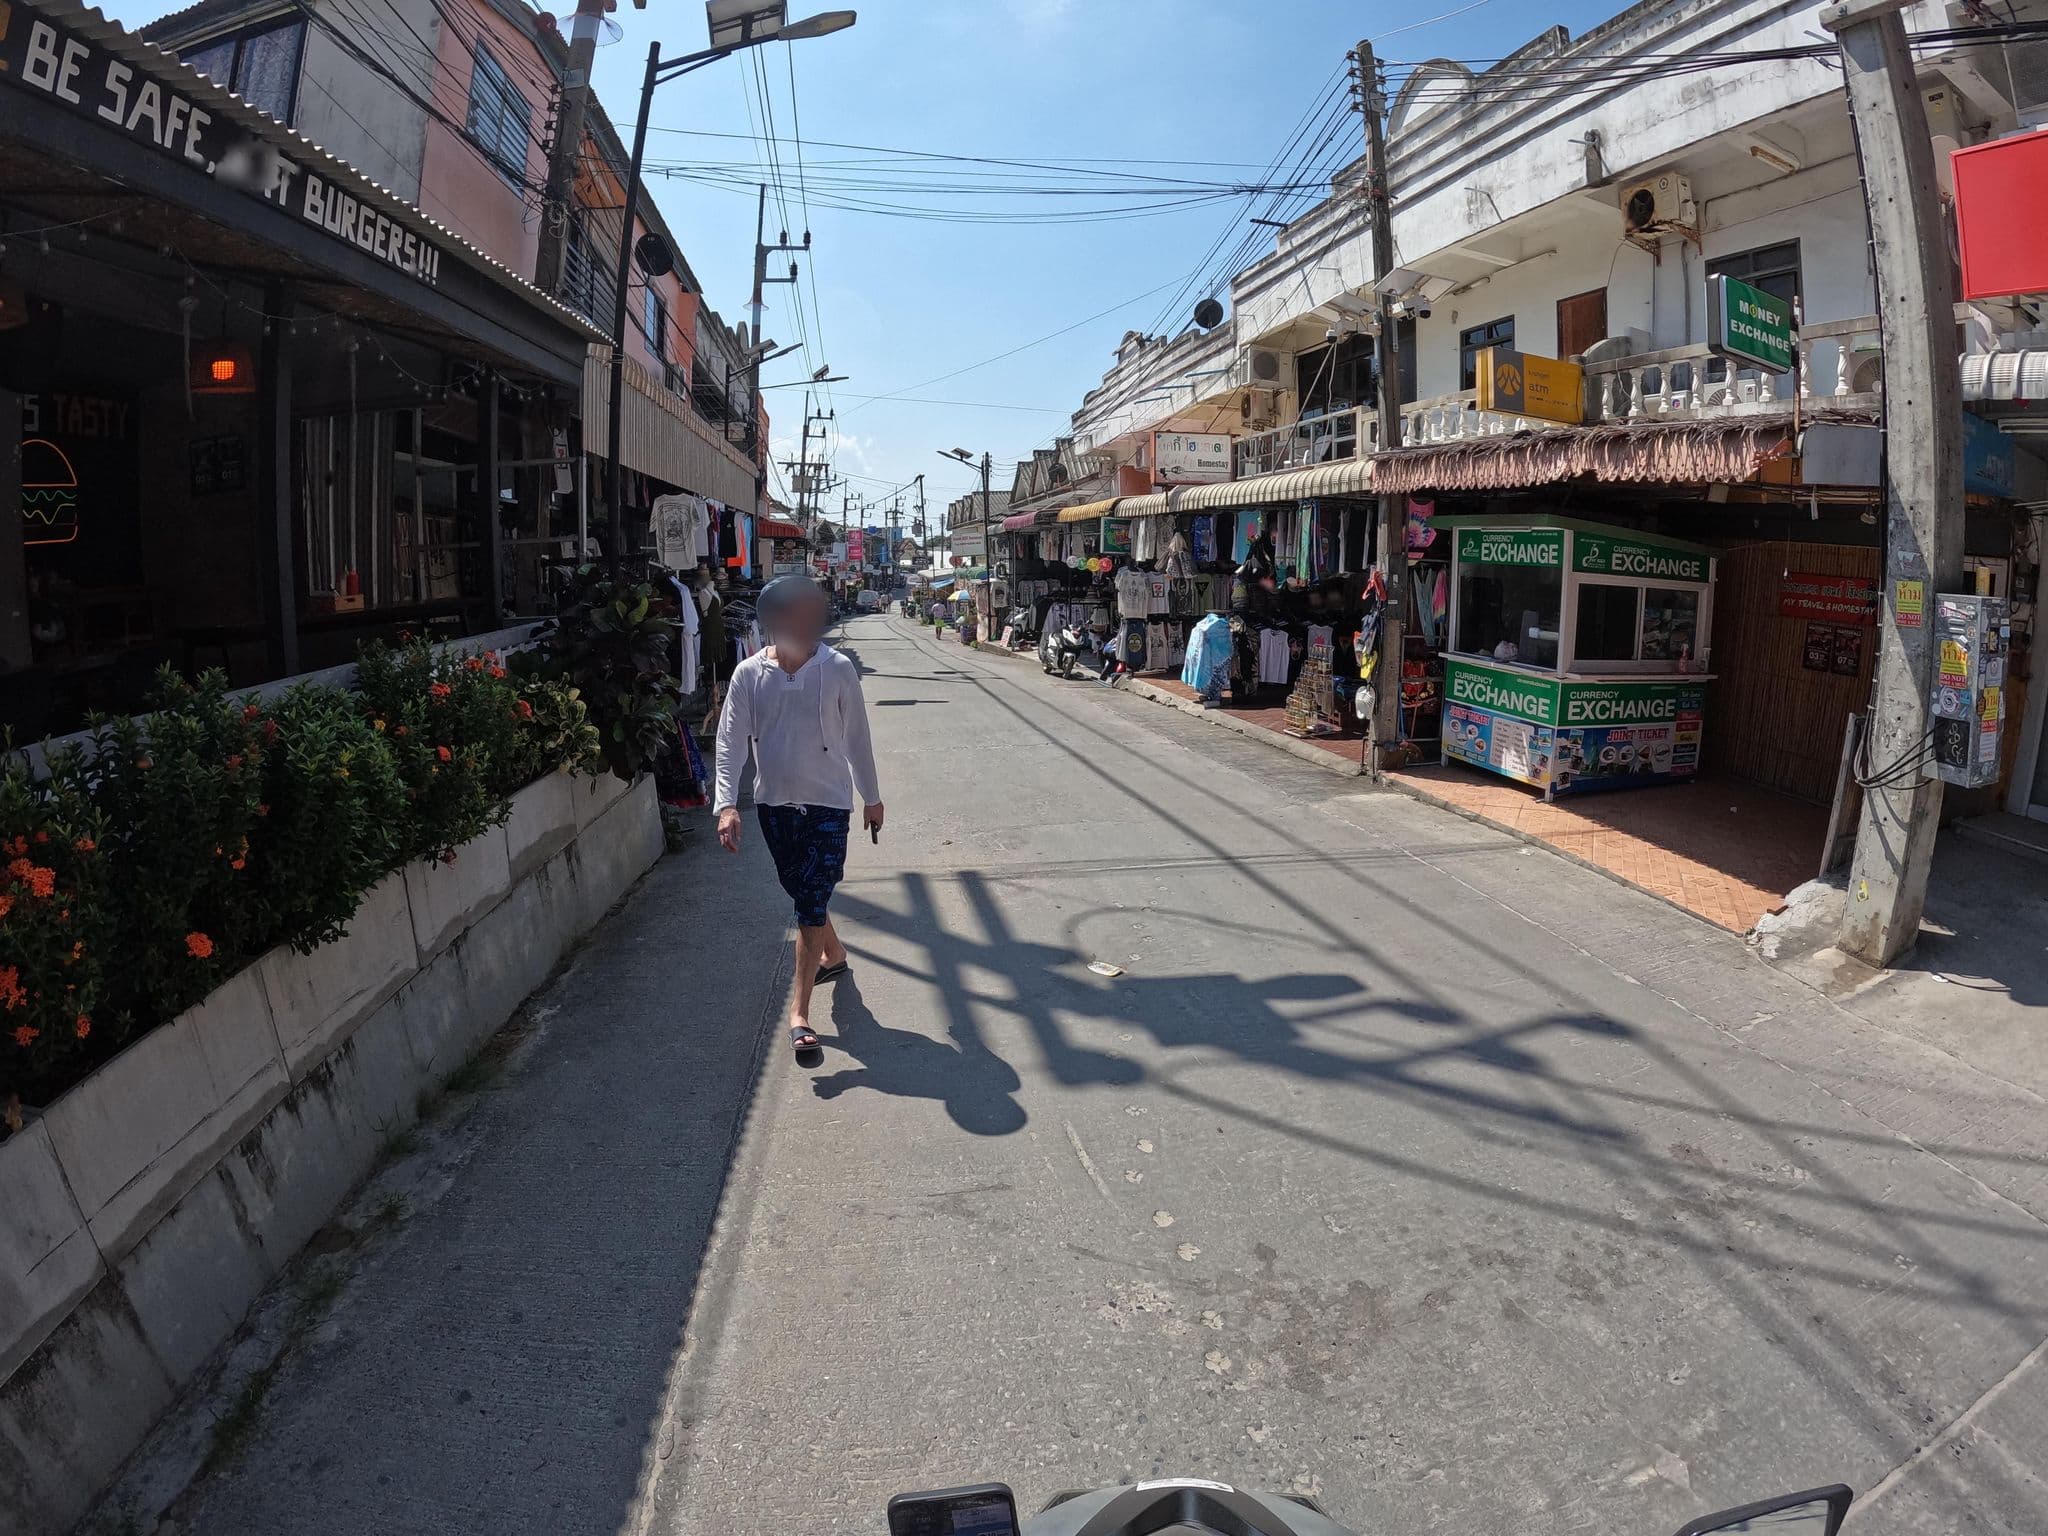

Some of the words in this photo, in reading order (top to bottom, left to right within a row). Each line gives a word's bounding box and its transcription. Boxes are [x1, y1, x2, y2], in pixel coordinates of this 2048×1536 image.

[22, 20, 90, 104] BE
[97, 59, 216, 174] SAFE,
[303, 174, 439, 286] BURGERS!!!
[1739, 300, 1781, 327] MONEY
[1730, 319, 1790, 353] EXCHANGE
[1528, 383, 1550, 395] atm
[51, 392, 129, 441] TASTY
[1197, 458, 1229, 470] Homestay
[1482, 534, 1514, 543] CURRENCY
[1481, 542, 1559, 565] EXCHANGE
[1613, 545, 1651, 556] CURRENCY
[1611, 552, 1700, 578] EXCHANGE
[1799, 599, 1825, 610] TRAVEL
[1832, 603, 1876, 616] HOMESTAY
[1455, 670, 1494, 686] CURRENCY
[1453, 678, 1551, 719] EXCHANGE
[1569, 690, 1620, 700] CURRENCY
[1567, 699, 1677, 721] EXCHANGE
[1607, 729, 1637, 742] JOINT
[1637, 728, 1670, 740] TICKET
